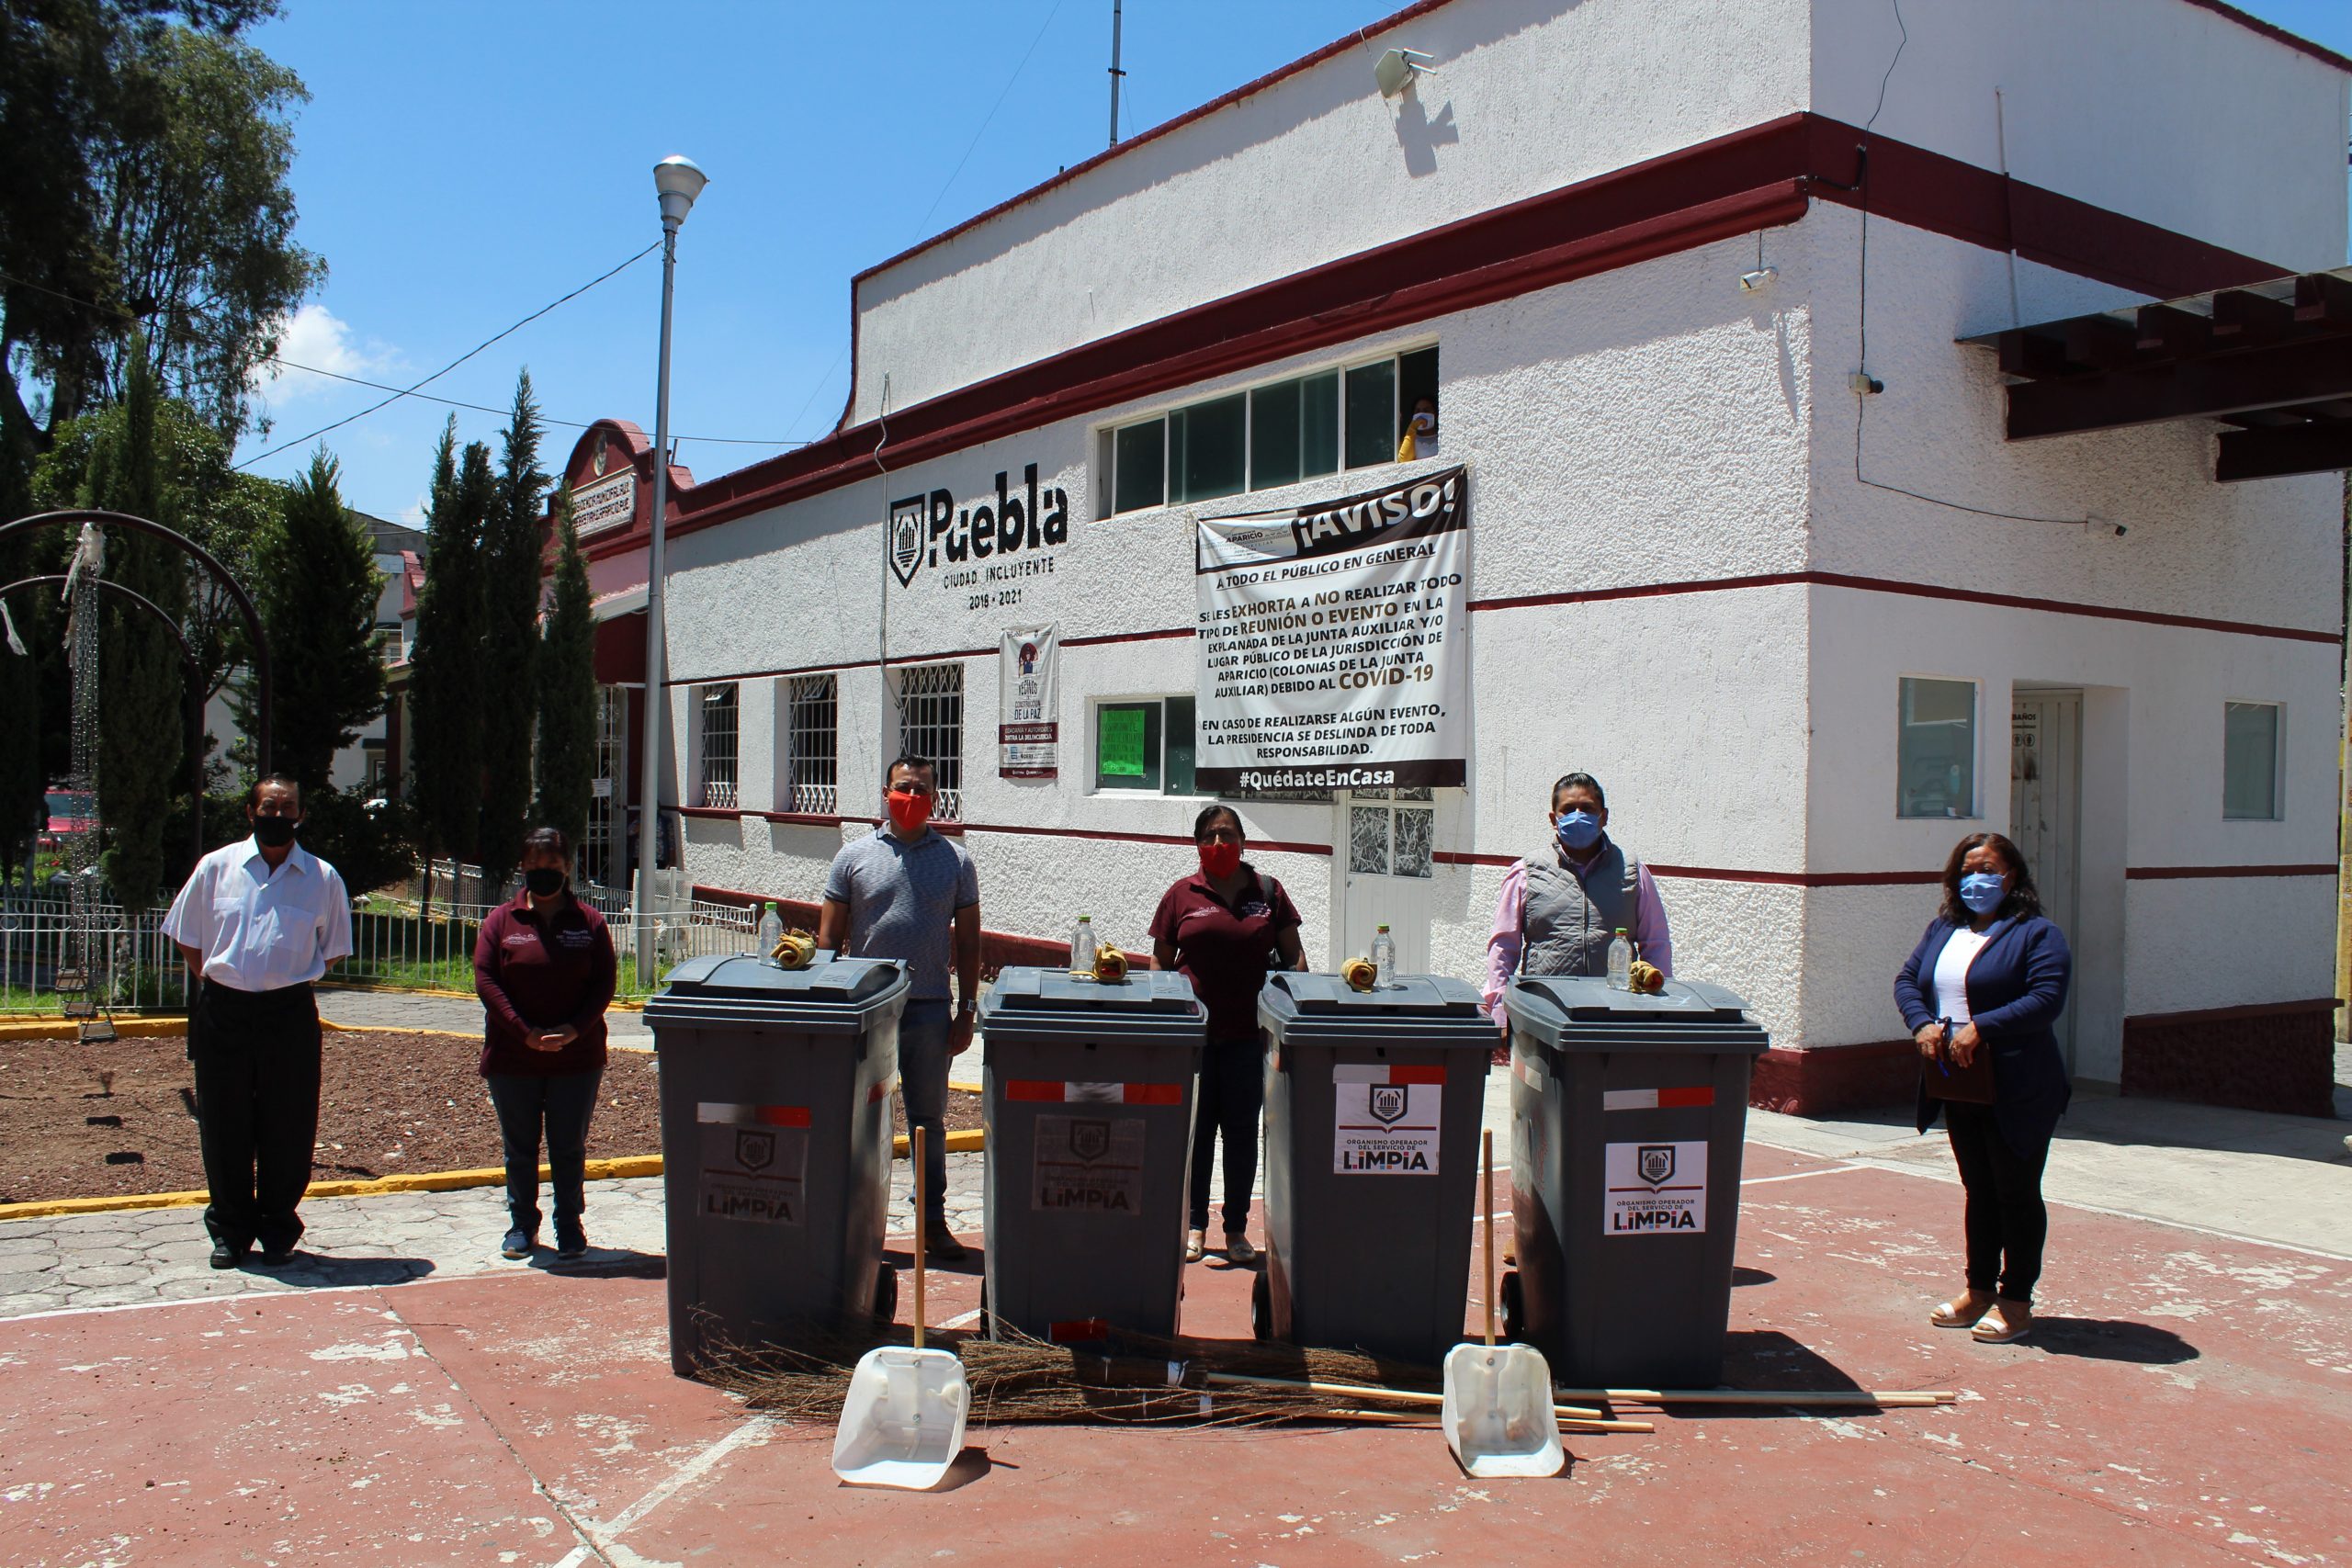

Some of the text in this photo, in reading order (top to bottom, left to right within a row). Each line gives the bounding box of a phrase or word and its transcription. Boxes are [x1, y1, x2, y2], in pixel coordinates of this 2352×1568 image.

[929, 463, 1068, 568] Puebla
[1297, 479, 1455, 547] ¡AVISO!
[1227, 532, 1263, 543] APARICIO
[944, 557, 1055, 589] CIUDAD INCLUYENTE
[1217, 543, 1436, 589] A TODO EL PÚBLICO EN GENERAL
[970, 594, 989, 610] 2018
[1000, 588, 1021, 605] 2021
[1199, 573, 1462, 623] SE LES EXHORTA A NO REALIZAR TODO
[1198, 597, 1443, 639] TIPO DE REUNIÓN O EVENTO EN LA
[1207, 615, 1443, 654] EXPLANADA DE LA JUNTA AUXILIAR Y/O
[1207, 632, 1442, 669] LUGAR PÚBLICO DE LA JURISDICCIÓN DE
[1215, 663, 1433, 698] AUXILIAR) DEBIDO AL COVID-19
[1217, 651, 1424, 682] APARICIO (COLONIAS DE LA JUNTA
[1014, 708, 1041, 720] DE LA PAZ
[1203, 703, 1446, 730] EN CASO DE REALIZARSE ALGÚN EVENTO,
[1207, 721, 1435, 745] LA PRESIDENCIA SE DESLINDA DE TODA
[1257, 743, 1373, 759] RESPONSABILIDAD.
[1239, 768, 1395, 791] #QuédateEnCasa
